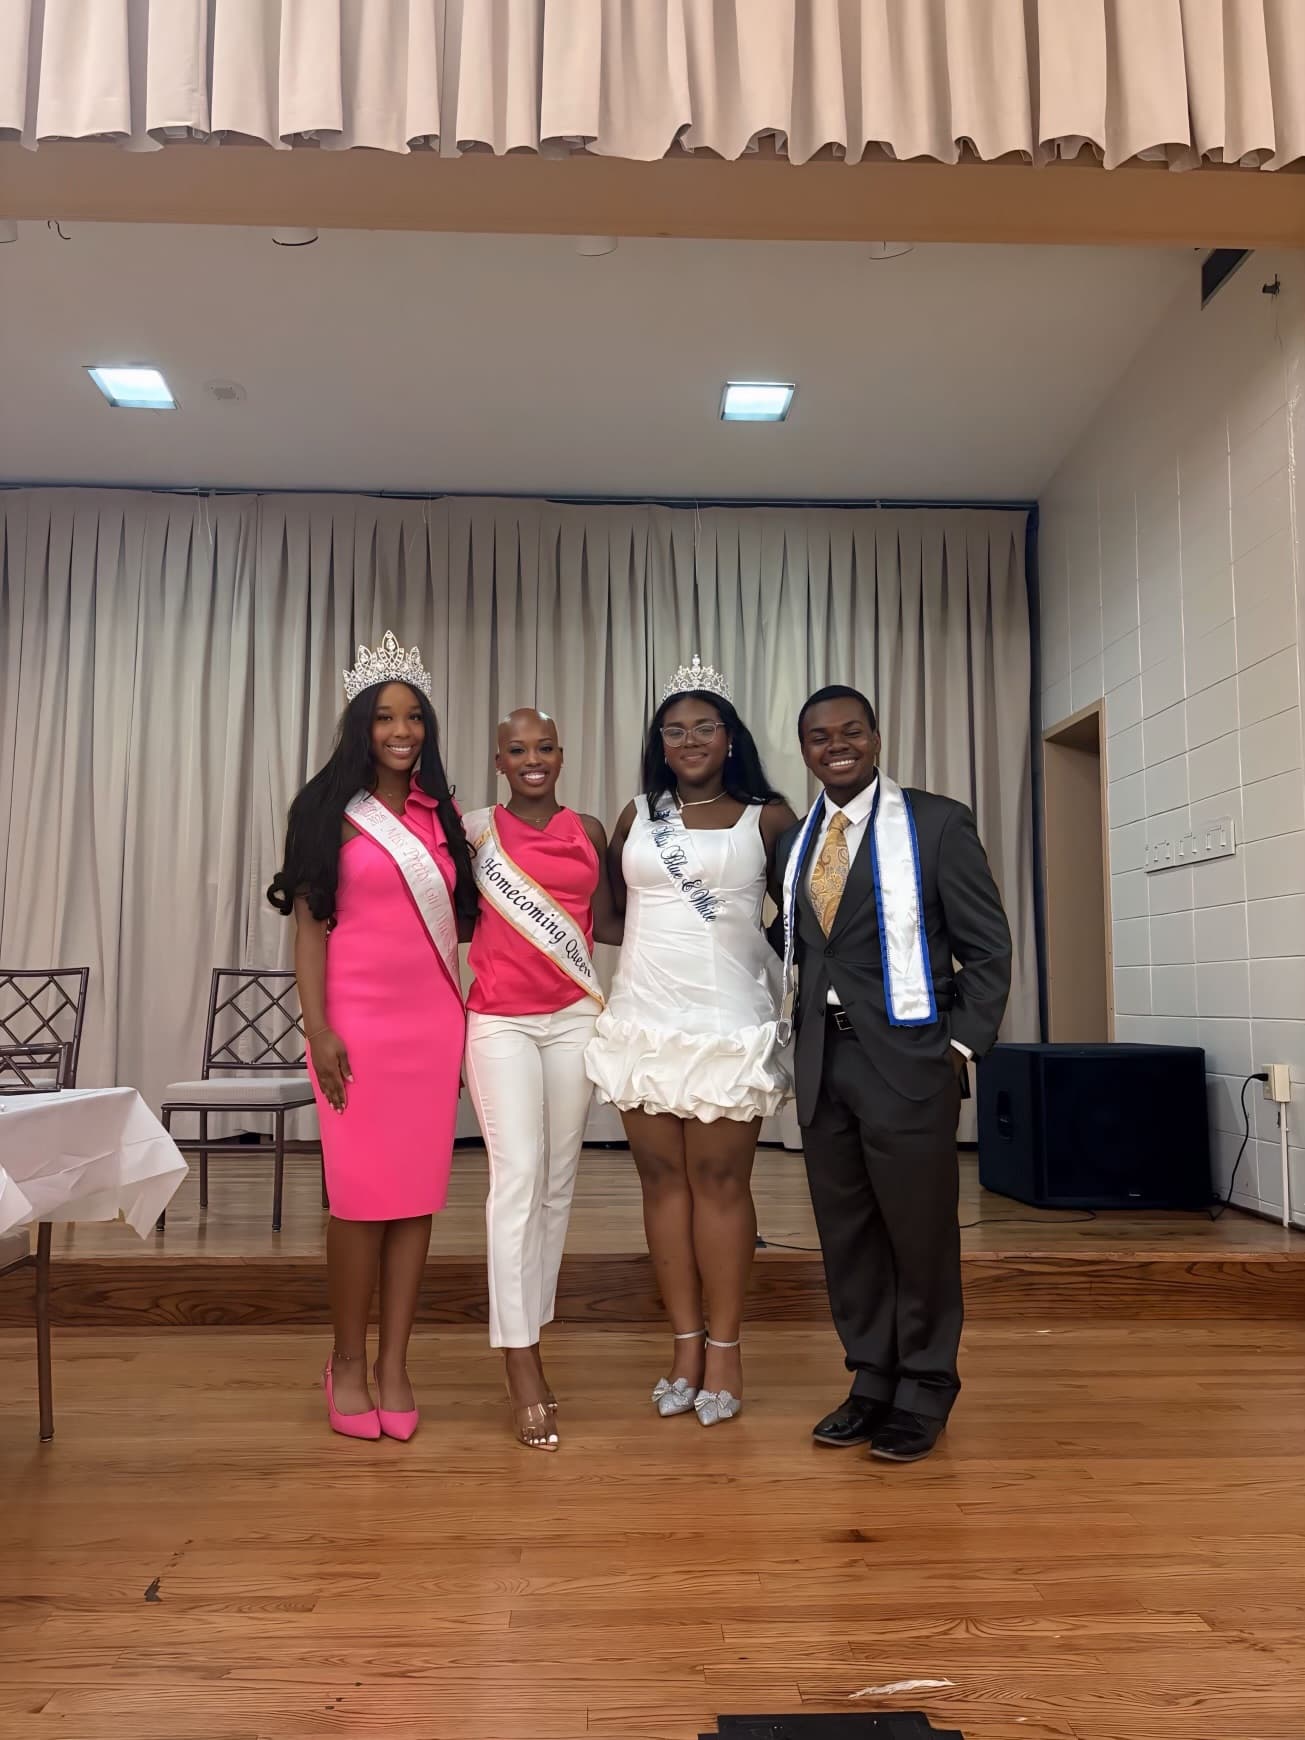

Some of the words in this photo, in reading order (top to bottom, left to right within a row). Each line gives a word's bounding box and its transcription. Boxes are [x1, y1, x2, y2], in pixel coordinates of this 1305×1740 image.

[403, 847, 431, 882] Pretty
[661, 845, 688, 879] Blue
[682, 879, 702, 892] &
[481, 857, 567, 945] Homecoming
[565, 938, 592, 978] Queen
[689, 888, 725, 922] White
